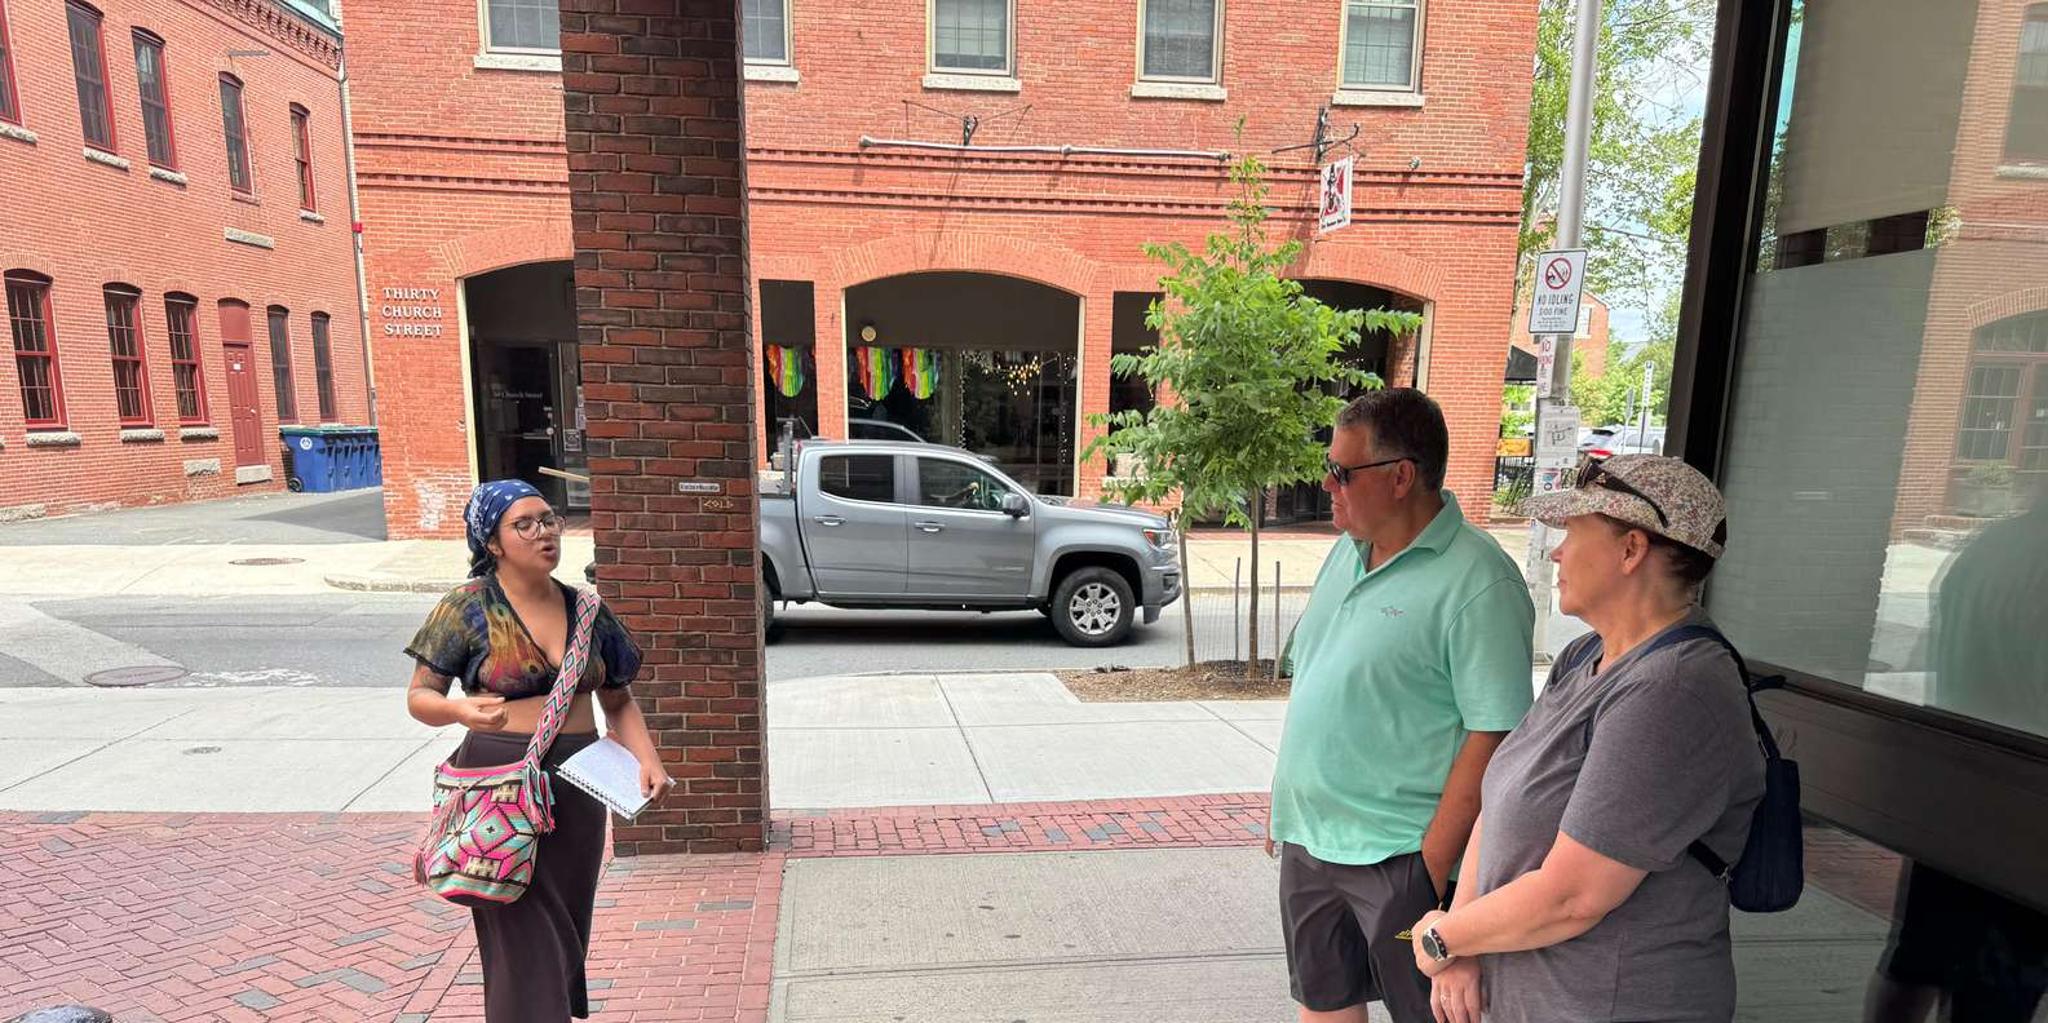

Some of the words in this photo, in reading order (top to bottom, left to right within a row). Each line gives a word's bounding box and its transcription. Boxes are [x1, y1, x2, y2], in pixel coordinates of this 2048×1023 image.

[383, 287, 440, 301] THIRTY
[1538, 294, 1547, 305] NO
[1548, 293, 1574, 305] IDLING
[382, 305, 442, 319] CHURCH
[383, 323, 443, 336] STREET
